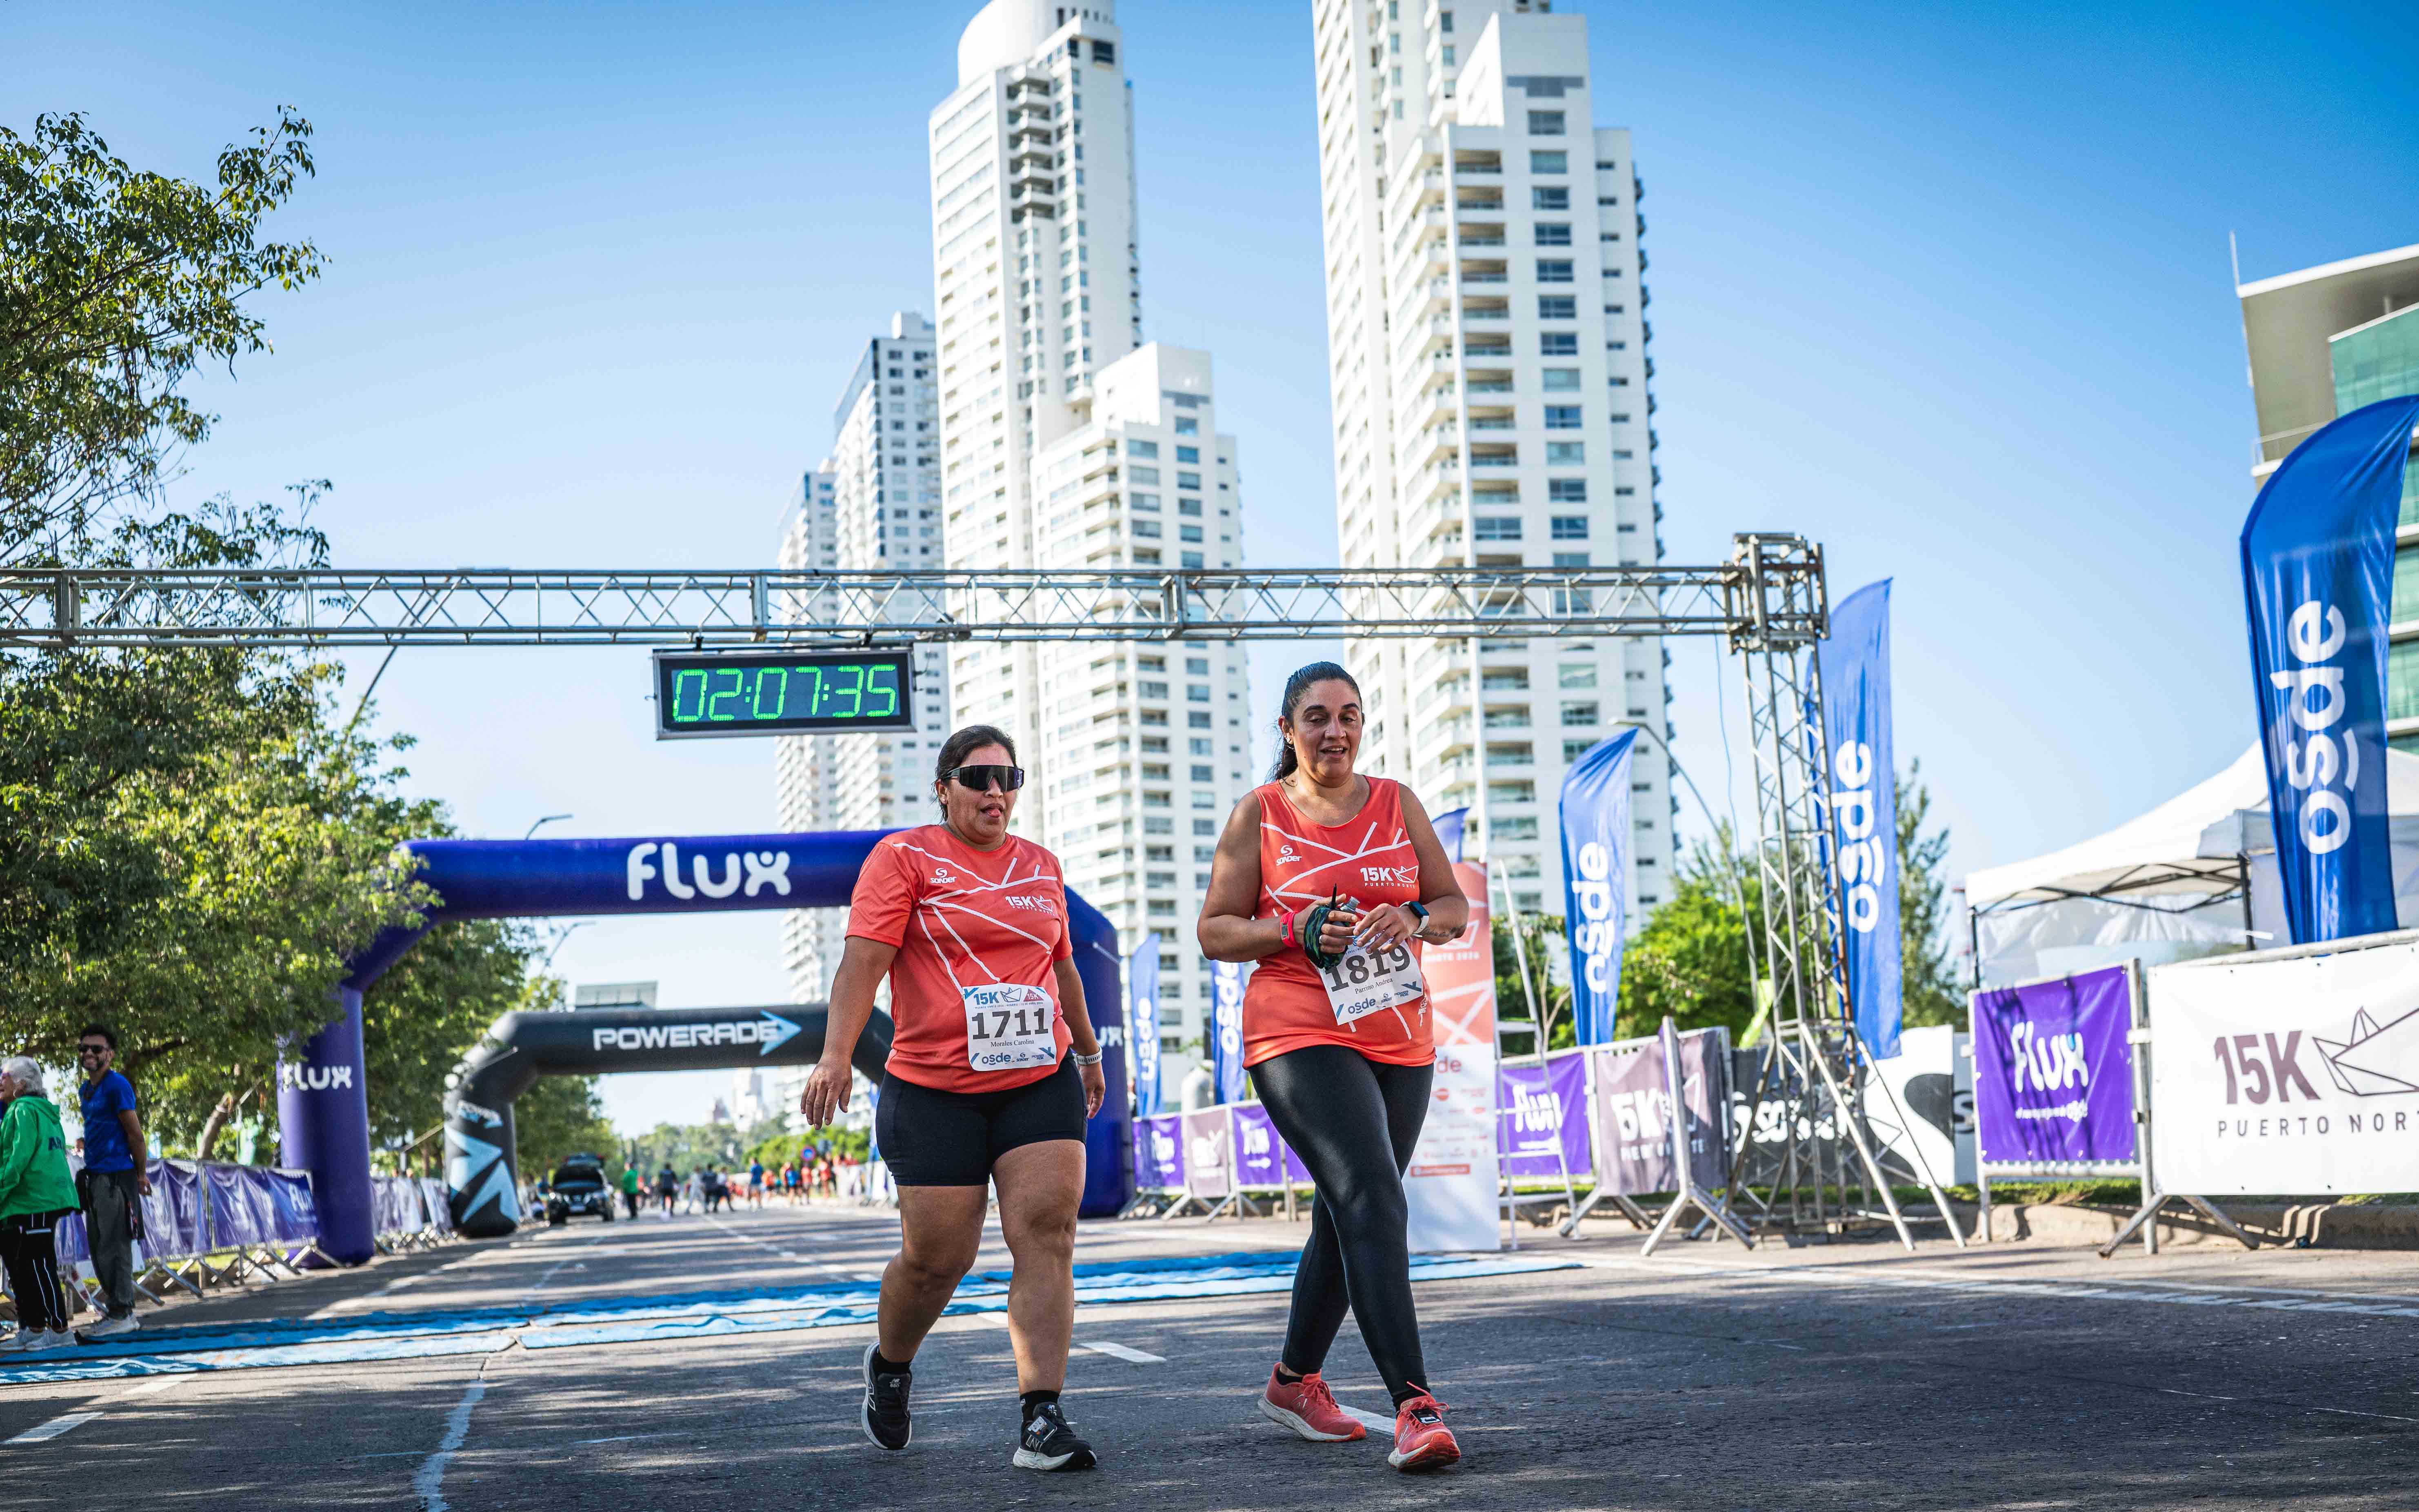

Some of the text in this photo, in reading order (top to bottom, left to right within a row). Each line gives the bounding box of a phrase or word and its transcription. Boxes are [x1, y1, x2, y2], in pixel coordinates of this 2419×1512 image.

[673, 664, 896, 722] 02:07:35
[2270, 599, 2359, 855] osde
[1831, 739, 1884, 933] osde
[1360, 867, 1393, 881] 15K
[1005, 896, 1035, 908] 15K
[1325, 945, 1411, 992] 1819
[973, 992, 1000, 1005] 15K
[1355, 977, 1393, 994] Parrino Andrea
[1348, 998, 1376, 1014] osde
[593, 1021, 780, 1051] POWERADE
[972, 1008, 1048, 1039] 1711
[982, 1052, 1011, 1065] osde
[2214, 1030, 2321, 1105] 15K
[2218, 1111, 2419, 1137] PUERTO NOR
